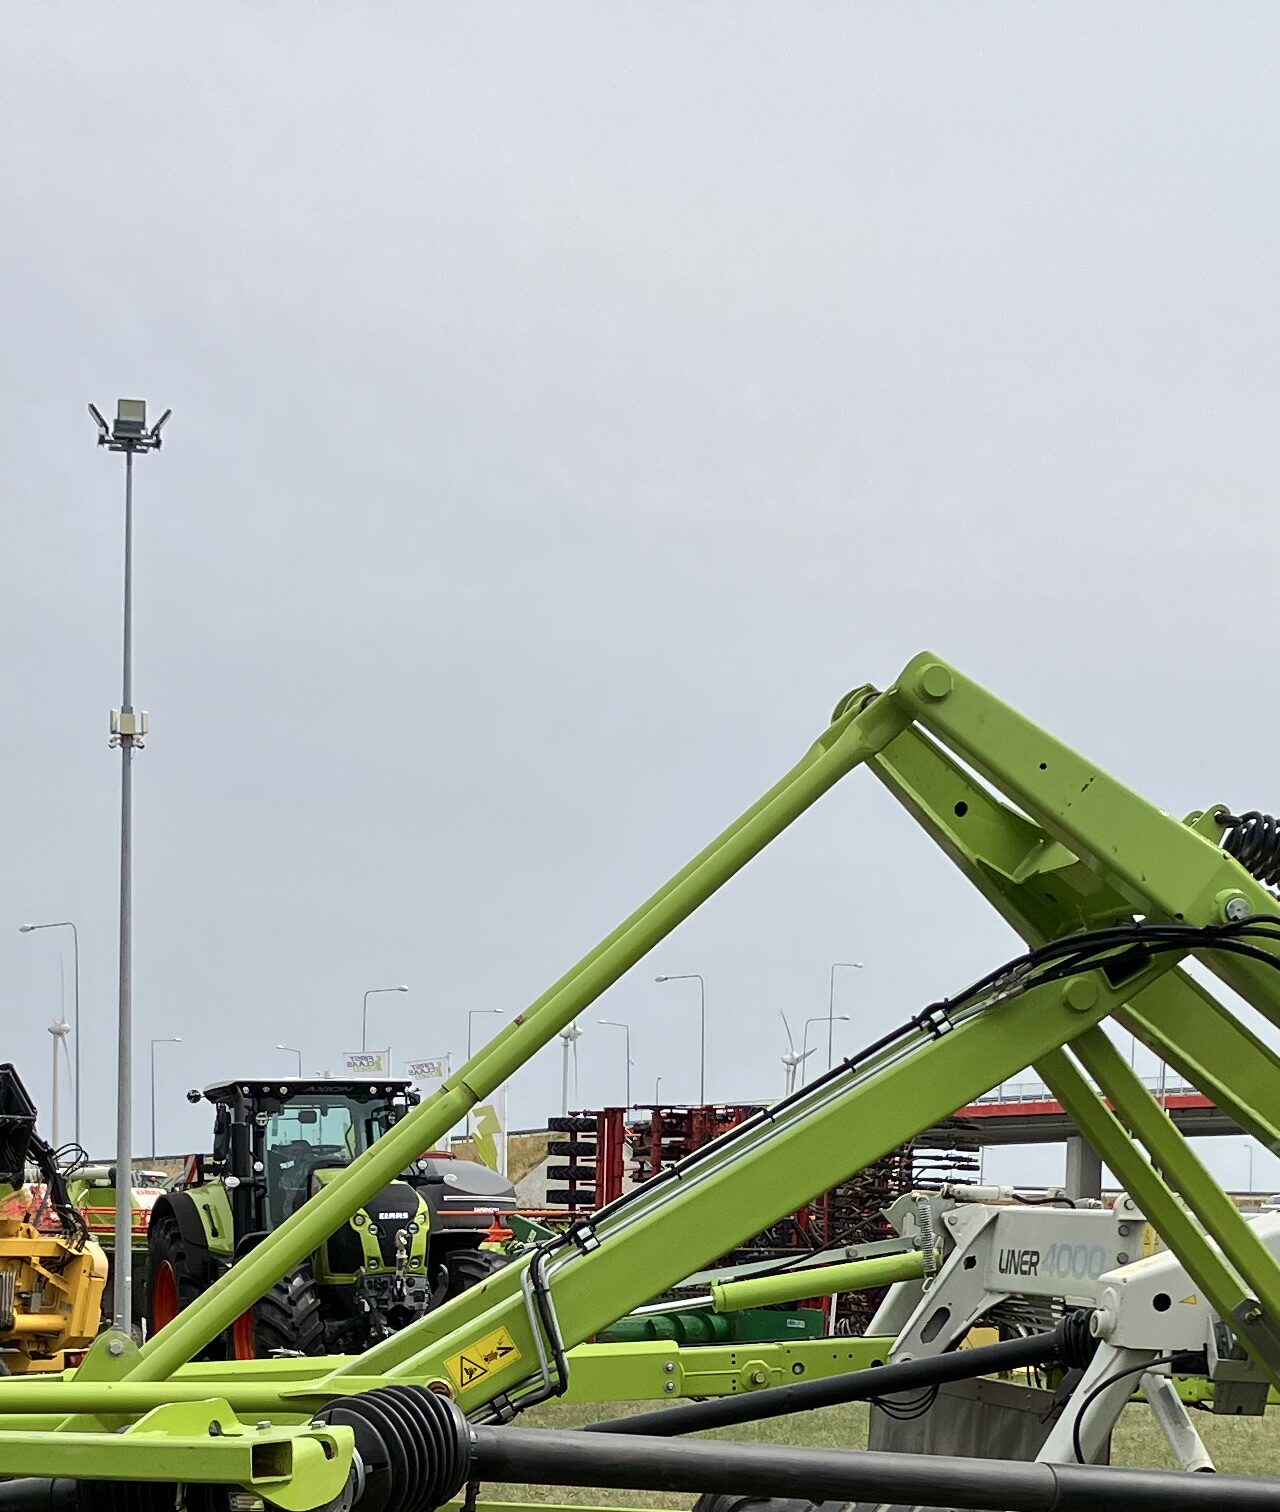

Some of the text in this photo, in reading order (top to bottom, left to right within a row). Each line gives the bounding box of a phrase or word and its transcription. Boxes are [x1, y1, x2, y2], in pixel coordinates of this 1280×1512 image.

[378, 1211, 409, 1220] CLAAS
[998, 1243, 1106, 1280] LINER 4000
